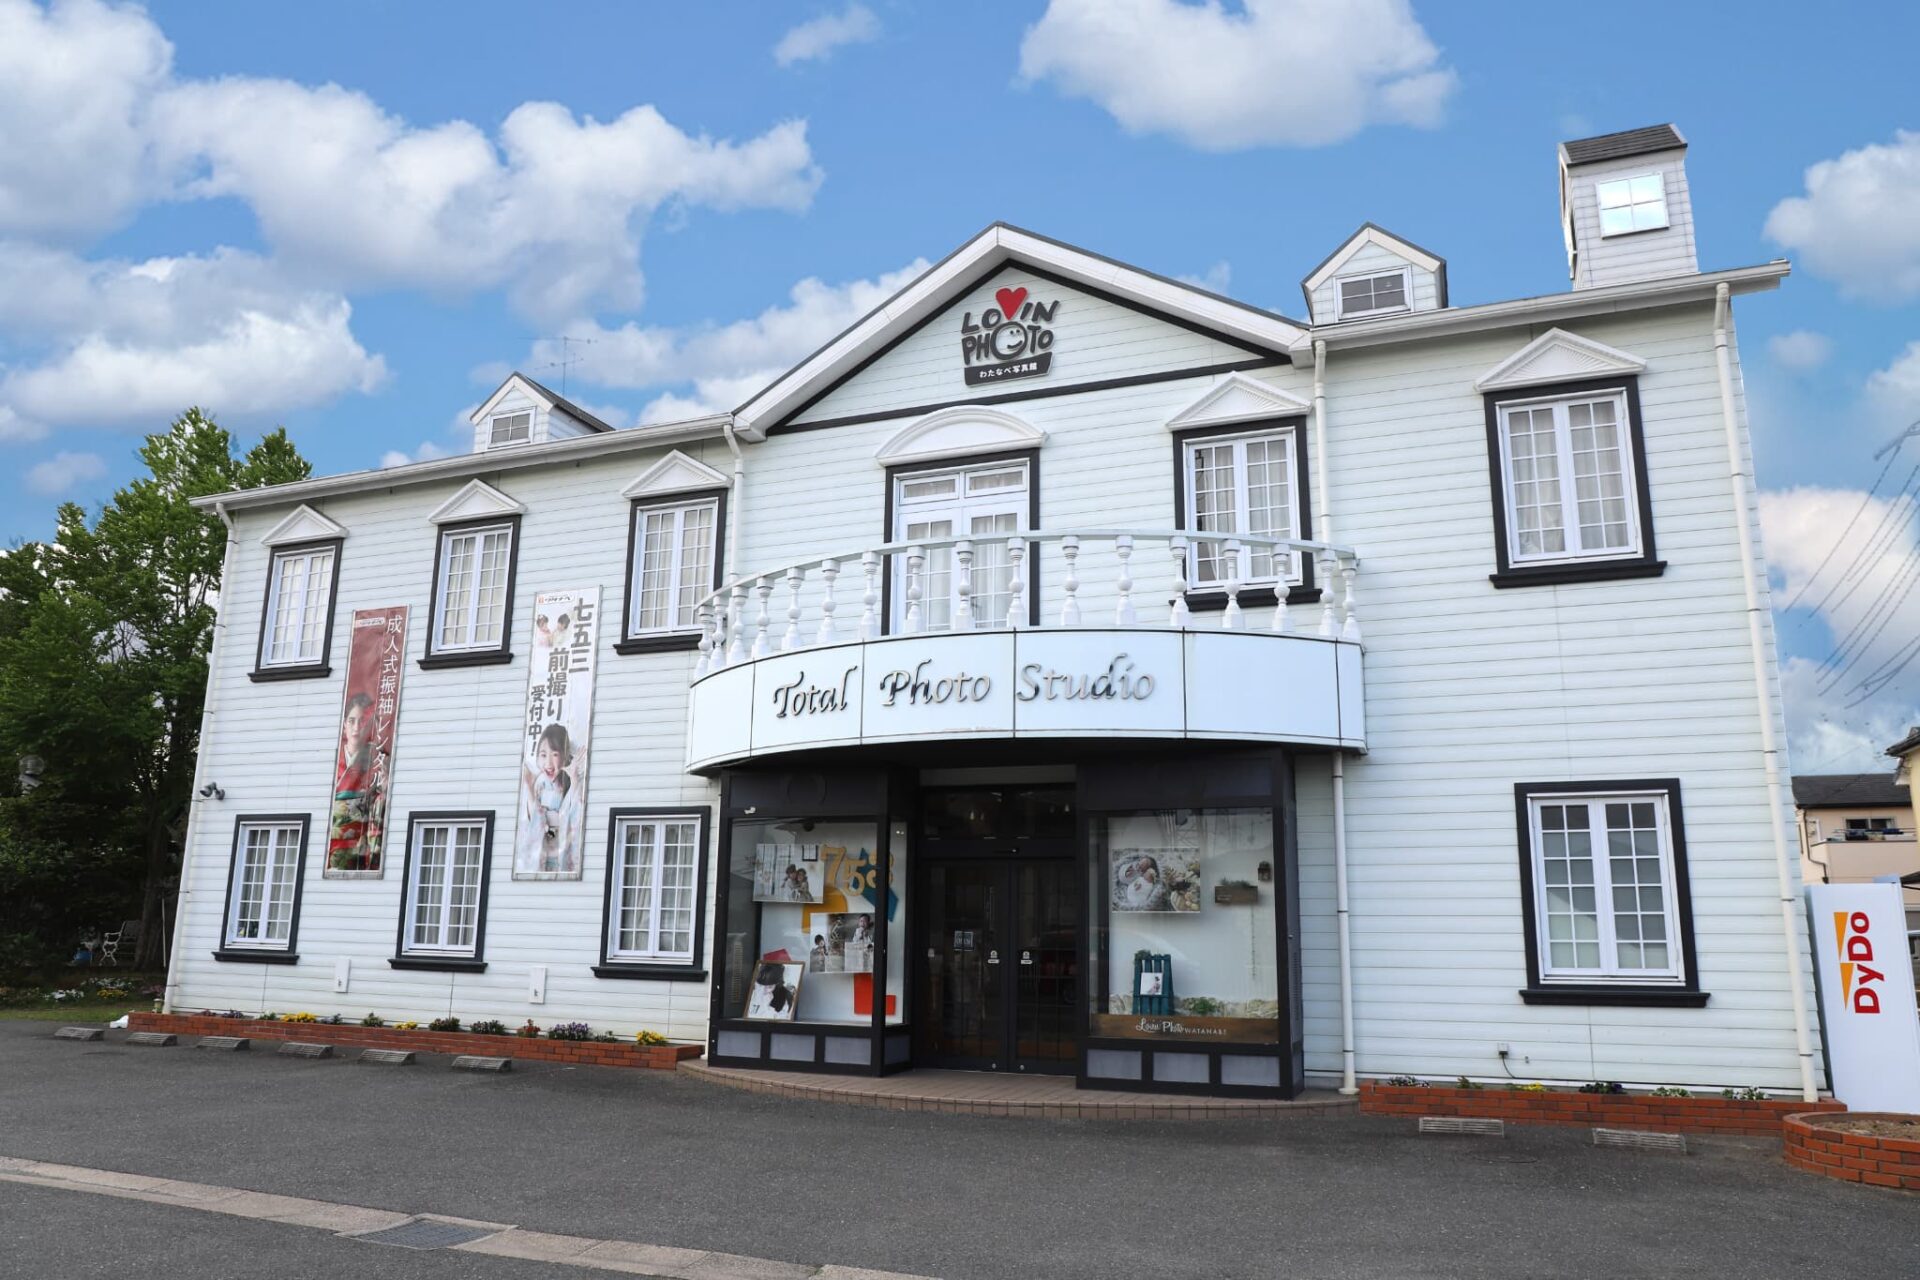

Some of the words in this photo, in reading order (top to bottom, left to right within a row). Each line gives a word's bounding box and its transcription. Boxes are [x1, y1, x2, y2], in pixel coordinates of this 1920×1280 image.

[961, 321, 1054, 366] PHOTO
[979, 362, 1038, 378] わたなべ写真館
[569, 598, 594, 673] 七五三
[370, 614, 404, 788] 成人式振袖レンタル
[546, 647, 570, 721] 前撮り
[773, 665, 858, 719] Total
[879, 657, 991, 706] Photo
[1016, 653, 1156, 702] Studio
[1847, 911, 1885, 1014] DyDo
